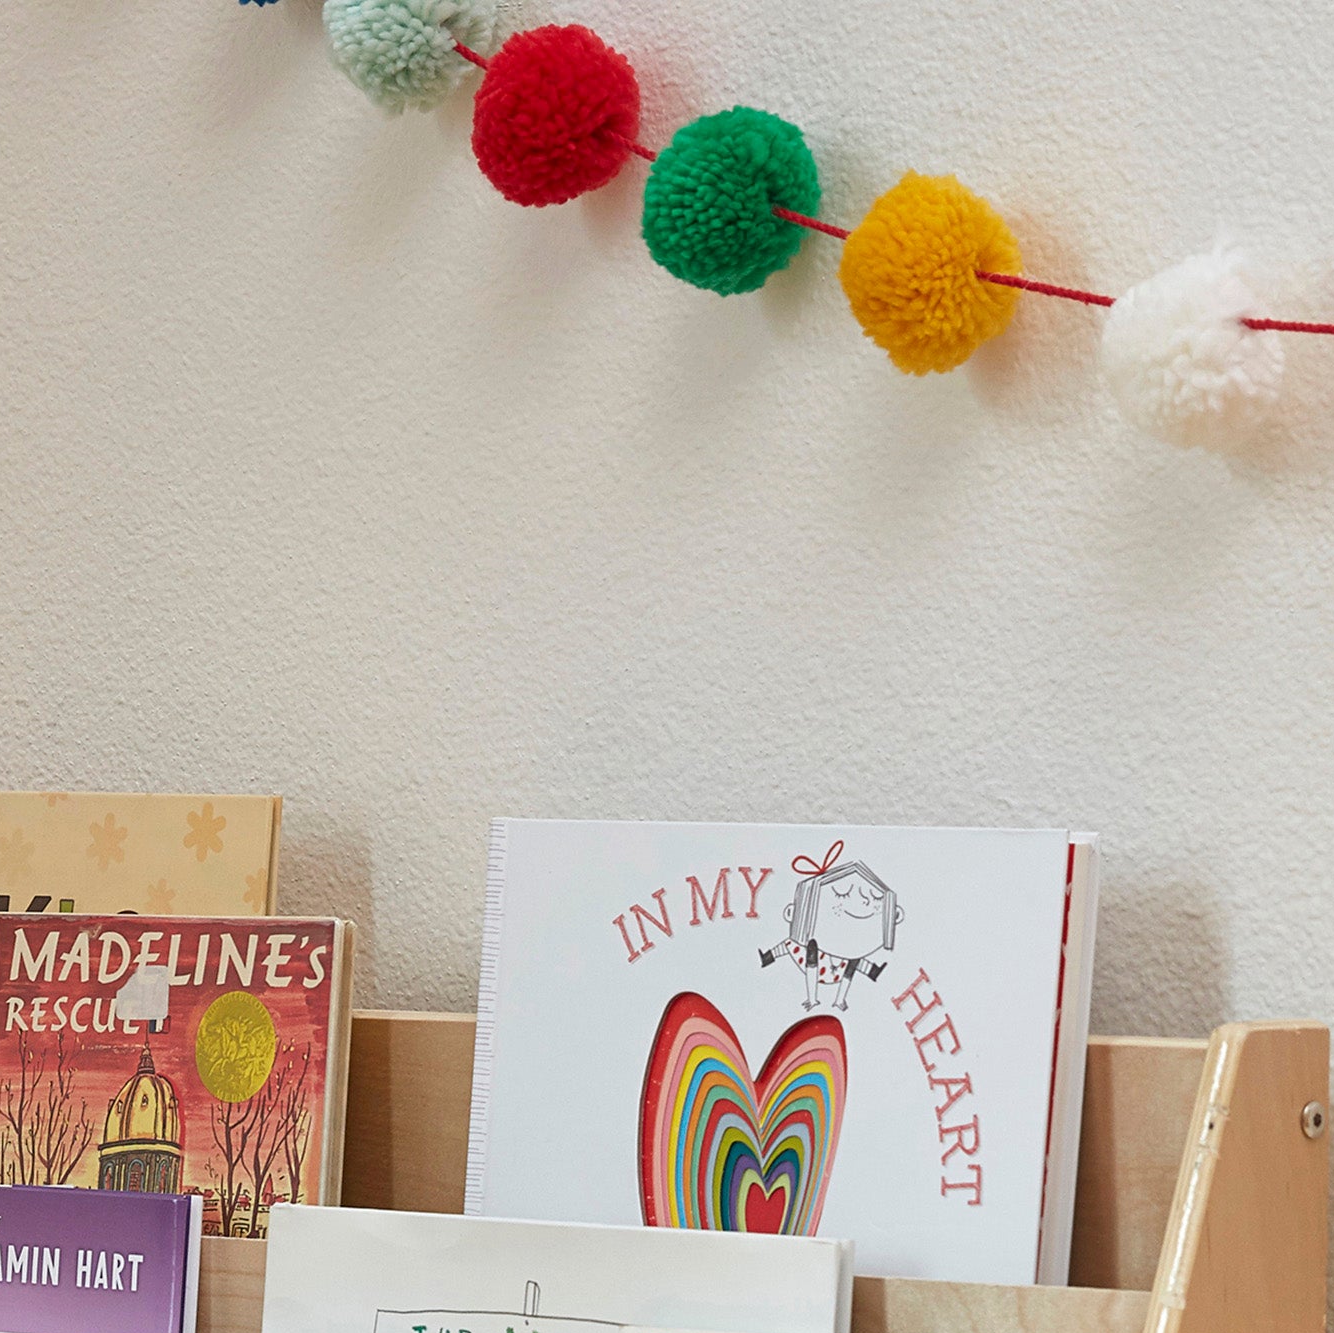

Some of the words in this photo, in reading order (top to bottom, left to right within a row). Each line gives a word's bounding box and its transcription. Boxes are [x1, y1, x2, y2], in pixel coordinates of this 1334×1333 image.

[612, 888, 674, 964] IN
[685, 866, 774, 927] MY
[890, 968, 984, 1207] HEART
[75, 1249, 144, 1292] HART
